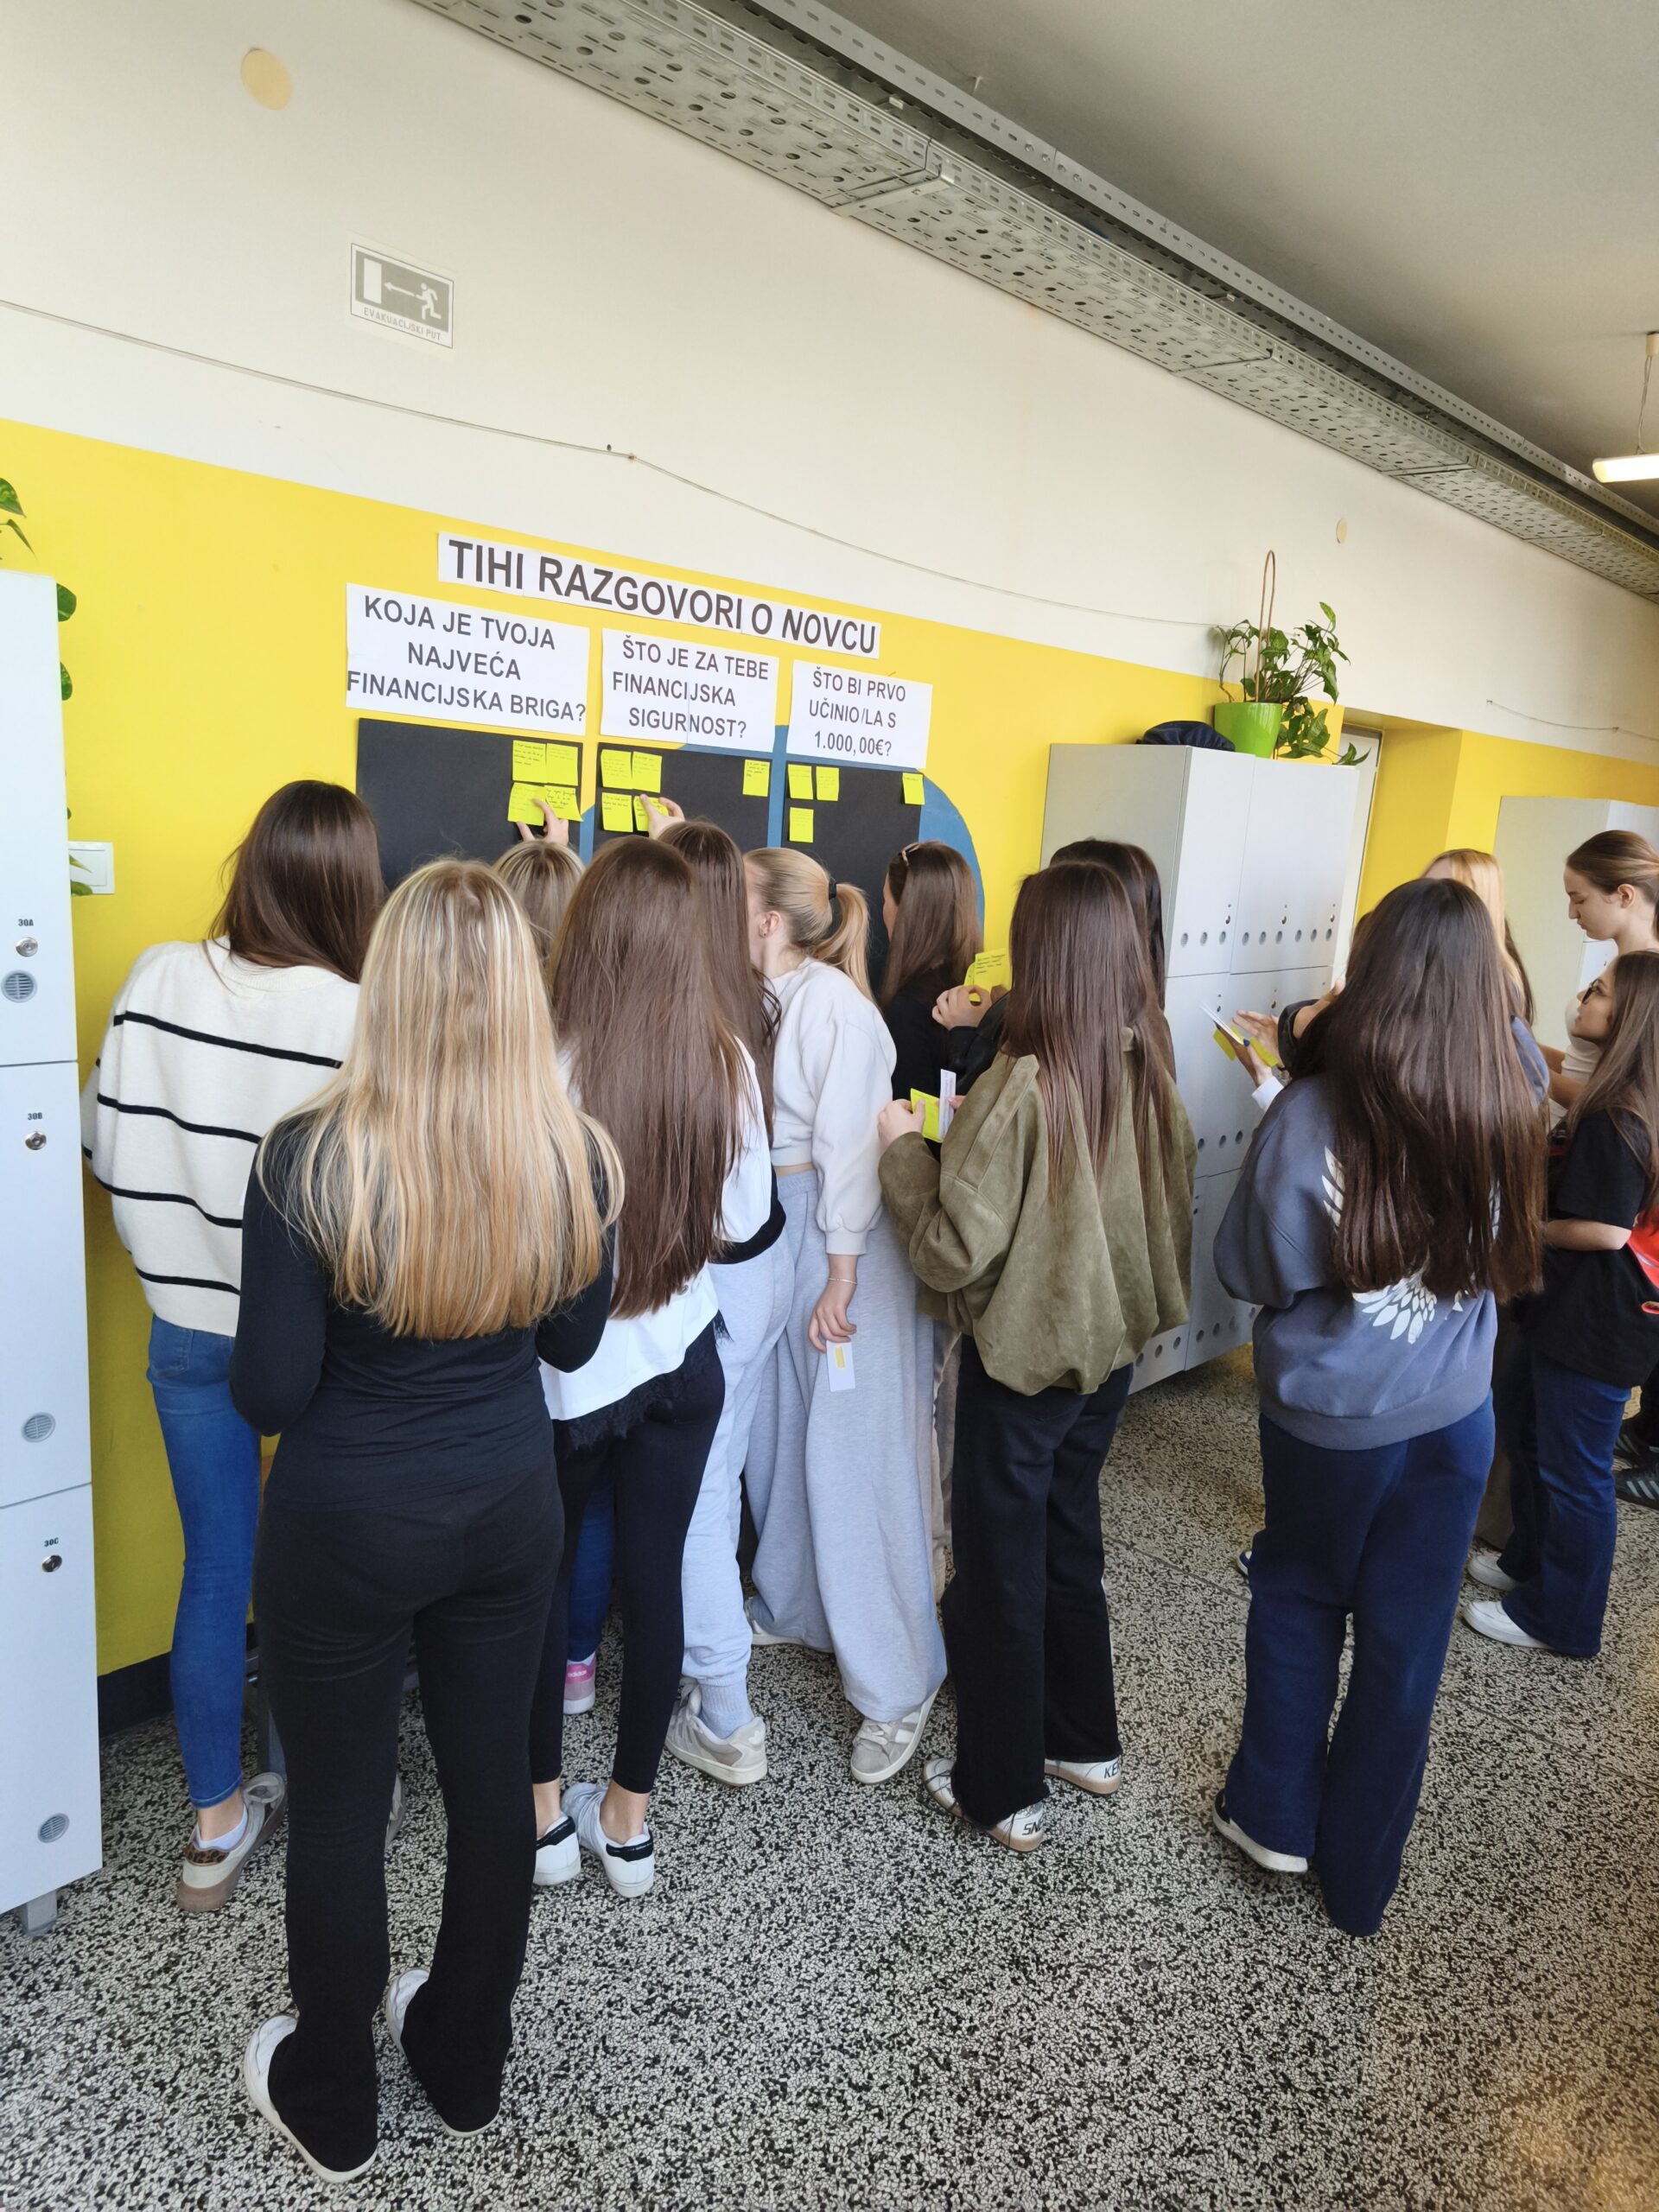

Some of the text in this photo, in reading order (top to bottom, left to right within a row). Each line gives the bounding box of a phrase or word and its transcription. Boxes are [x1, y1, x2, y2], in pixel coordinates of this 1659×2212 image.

[364, 307, 442, 340] EVAKUACIJSKI PUT
[448, 539, 876, 654] TIHI RAZGOVORI O NOVCU
[365, 594, 556, 651] KOJA JE TVOJA
[408, 641, 521, 681] NAJVEĆA
[622, 634, 769, 680] ŠTO JE ZA TEBE
[346, 670, 586, 721] FINANCIJSKA BRIGA?
[613, 671, 736, 707] FINANCIJSKA
[812, 666, 906, 702] ŠTO BI PRVO
[628, 707, 747, 738] SIGURNOST?
[809, 697, 896, 728] UČINIO/LA S
[815, 731, 892, 756] 1.000,00€?
[17, 918, 35, 927] 30A
[27, 1111, 43, 1121] 30B
[43, 1536, 60, 1548] 30C
